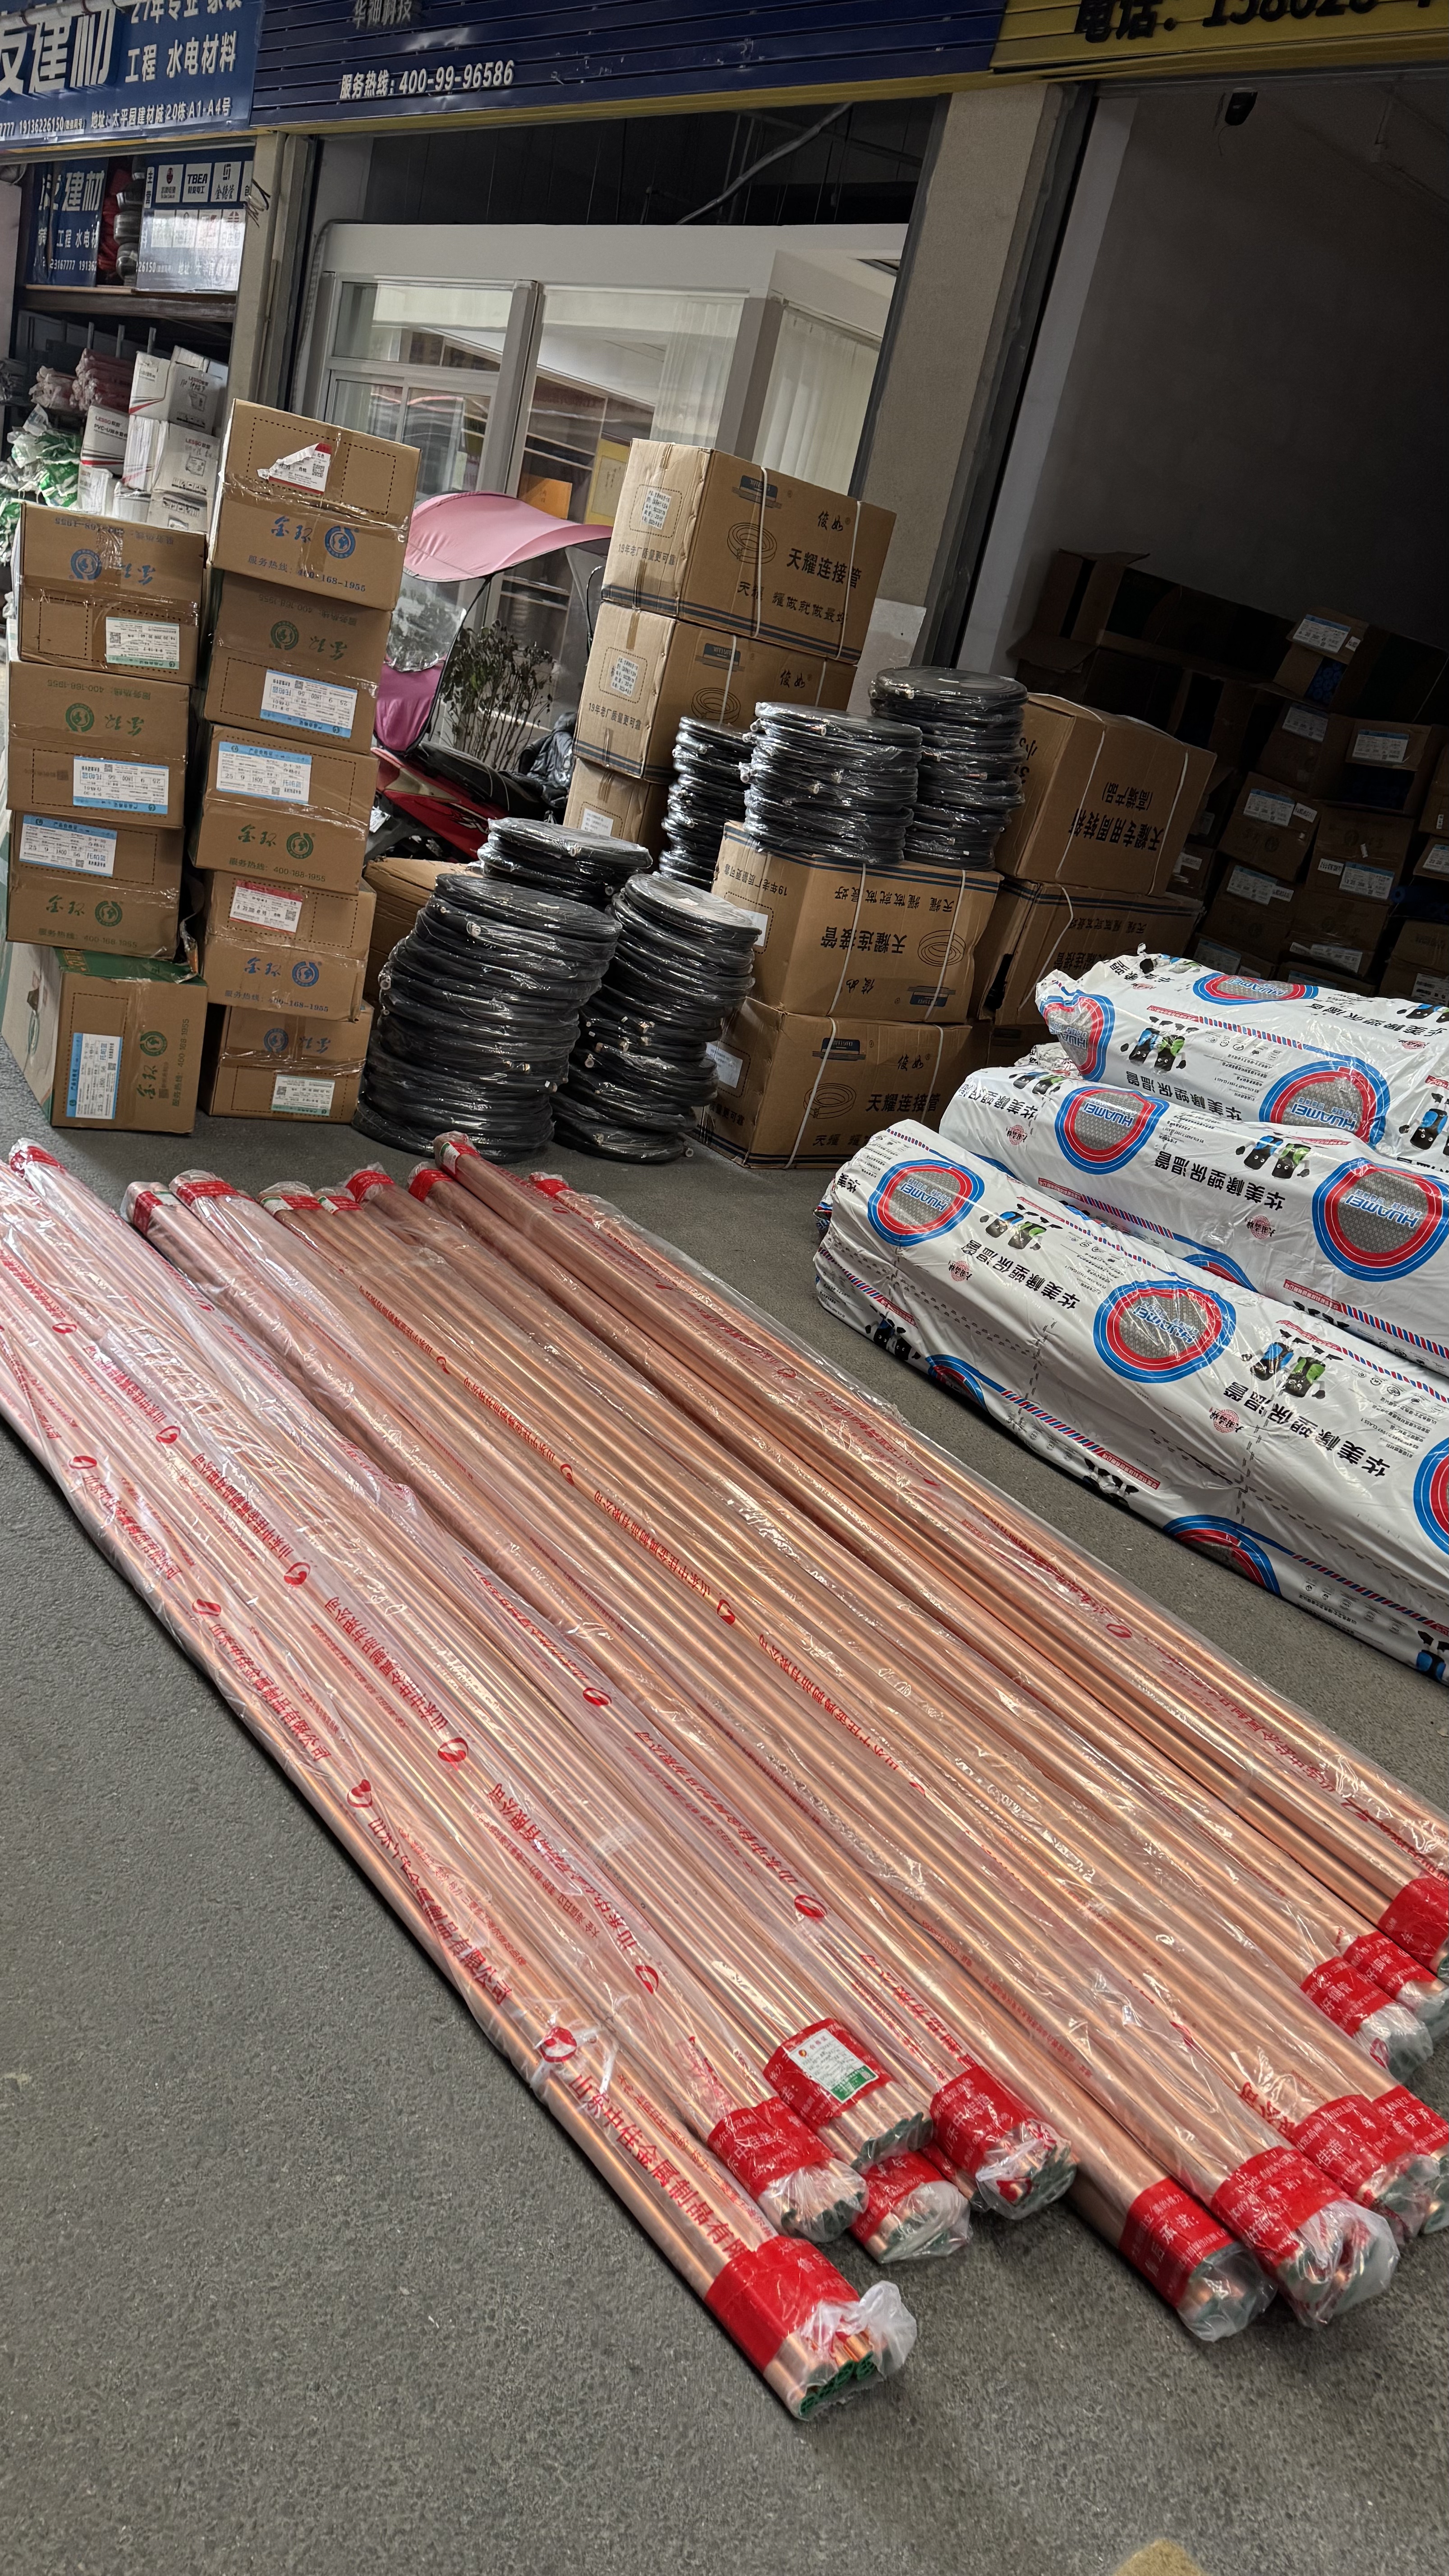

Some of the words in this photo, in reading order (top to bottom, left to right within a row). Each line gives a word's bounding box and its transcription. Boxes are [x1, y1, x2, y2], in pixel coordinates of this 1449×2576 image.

[125, 44, 157, 83] 工程
[166, 30, 237, 78] 水电材料
[187, 173, 208, 184] TBEA
[96, 415, 111, 425] LESSO
[787, 547, 862, 589] 天耀连接管
[820, 926, 908, 954] 天耀连接管
[865, 1093, 942, 1113] 天耀连接管
[1081, 1102, 1134, 1127] HUAMEI
[1126, 1069, 1243, 1121] 华美橡塑保温管
[1291, 1104, 1357, 1131] HUAMEI
[900, 1183, 948, 1212] HUAMEI
[1154, 1150, 1288, 1212] 华美橡塑保温管
[1344, 1194, 1420, 1228] HUAMEI
[961, 1239, 1082, 1311] 华美橡塑保温管
[1132, 1305, 1194, 1344] HUAMEI
[1224, 1381, 1392, 1478] 华美橡塑保温管
[191, 1452, 295, 1559] 山东中佳金属制品有限公司
[593, 1490, 711, 1597] 山东中佳金属制品有限公司
[324, 1596, 449, 1731] 山东中佳金属制品有限公司
[209, 1624, 332, 1762] 山东中佳金属制品有限公司
[555, 1893, 587, 1925] 海信日立
